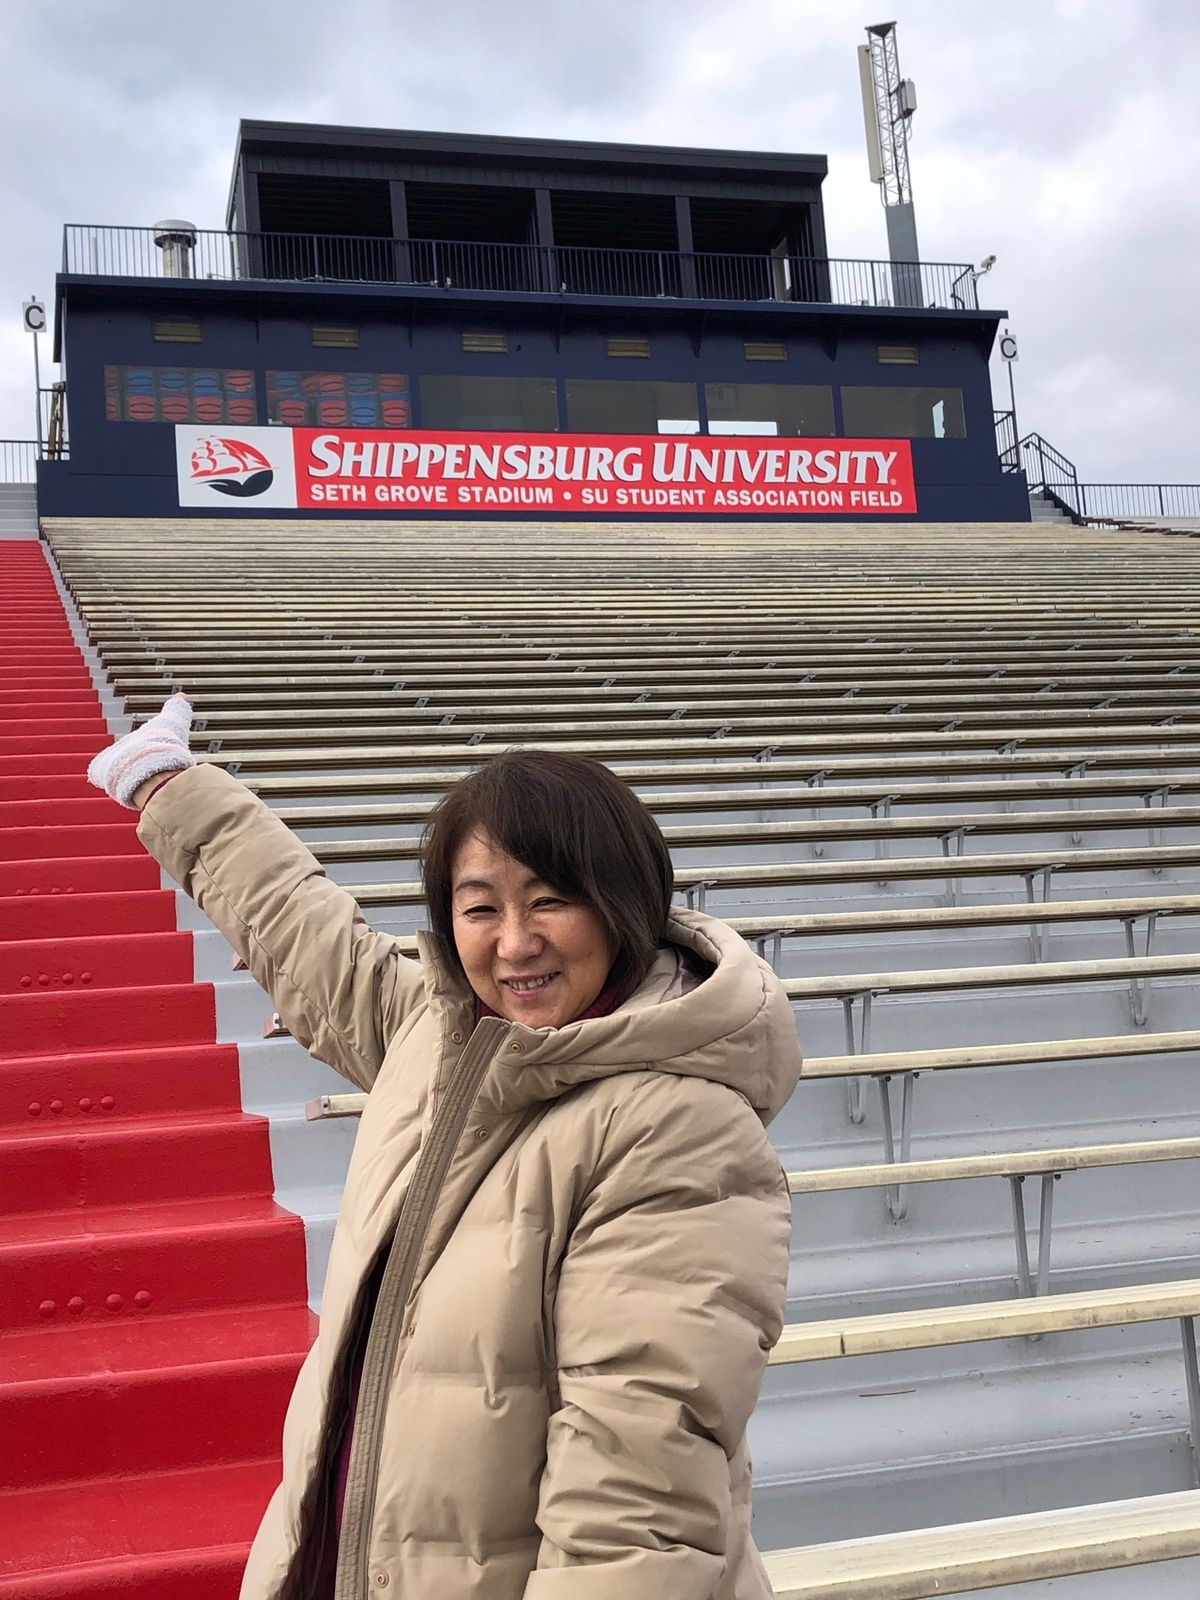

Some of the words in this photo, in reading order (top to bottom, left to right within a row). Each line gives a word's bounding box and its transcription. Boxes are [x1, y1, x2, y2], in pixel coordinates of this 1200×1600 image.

[25, 305, 45, 330] C
[1000, 338, 1017, 359] C
[307, 434, 643, 482] SHIPPENSBURG
[310, 483, 367, 503] SETH
[374, 485, 448, 504] GROVE
[457, 486, 553, 505] STADIUM
[581, 488, 608, 505] SU
[616, 488, 706, 506] STUDENT
[713, 489, 843, 507] ASSOCIATION
[850, 490, 903, 507] FIELD
